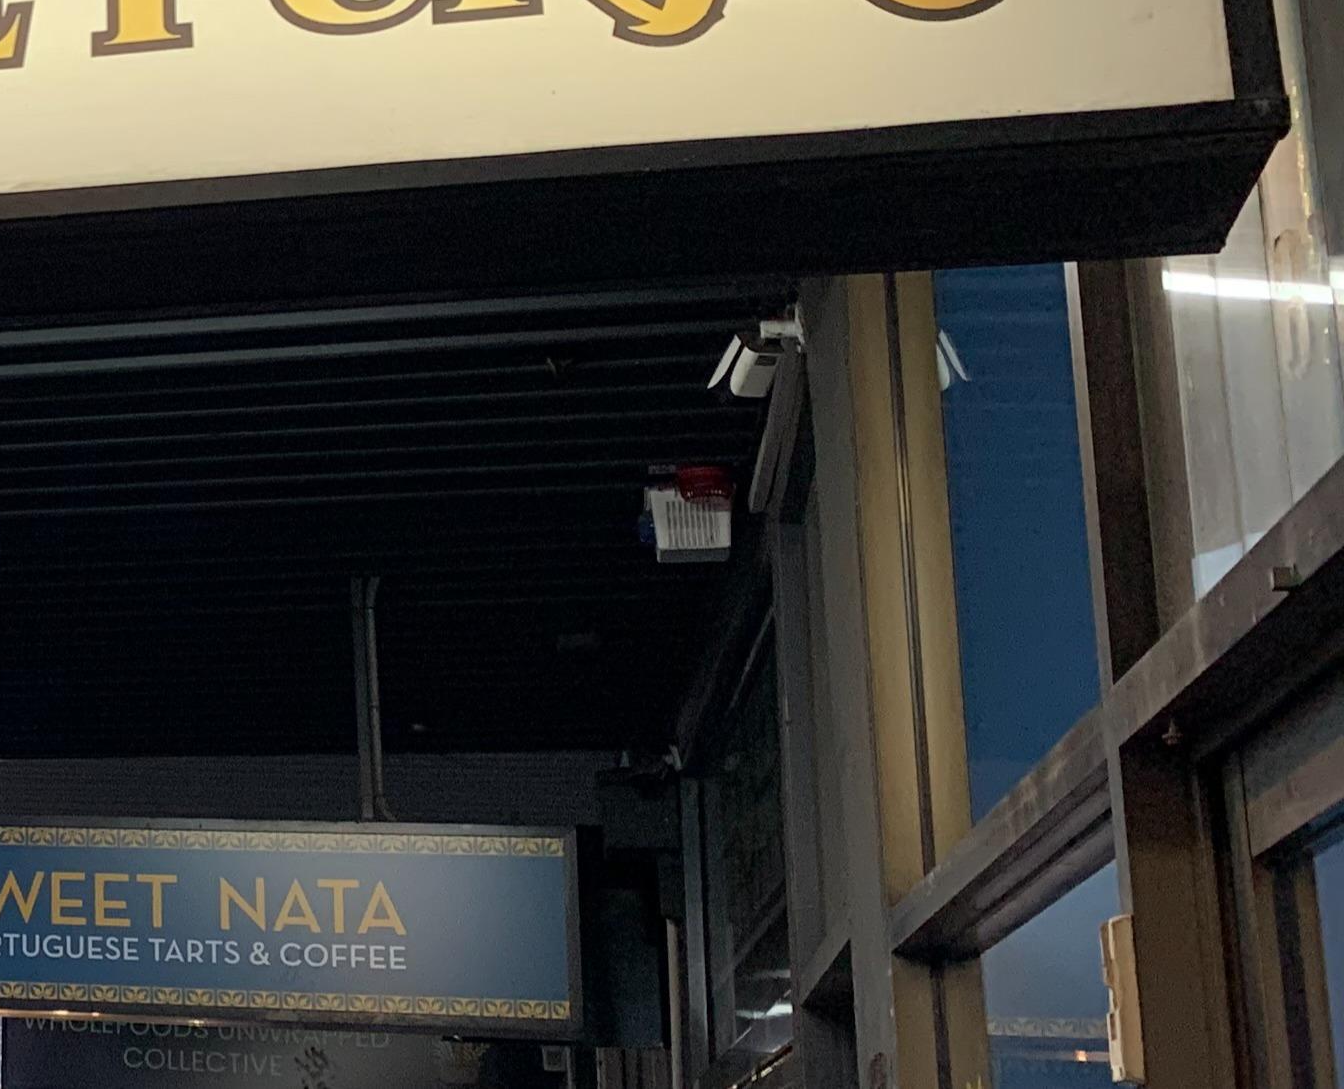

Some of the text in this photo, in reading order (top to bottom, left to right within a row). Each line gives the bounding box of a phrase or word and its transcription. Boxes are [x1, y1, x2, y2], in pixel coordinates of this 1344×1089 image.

[219, 876, 408, 937] NATA
[148, 938, 241, 965] TARTS
[250, 942, 273, 967] &
[279, 942, 408, 970] COFFEE
[122, 1046, 283, 1077] COLLECTIVE
